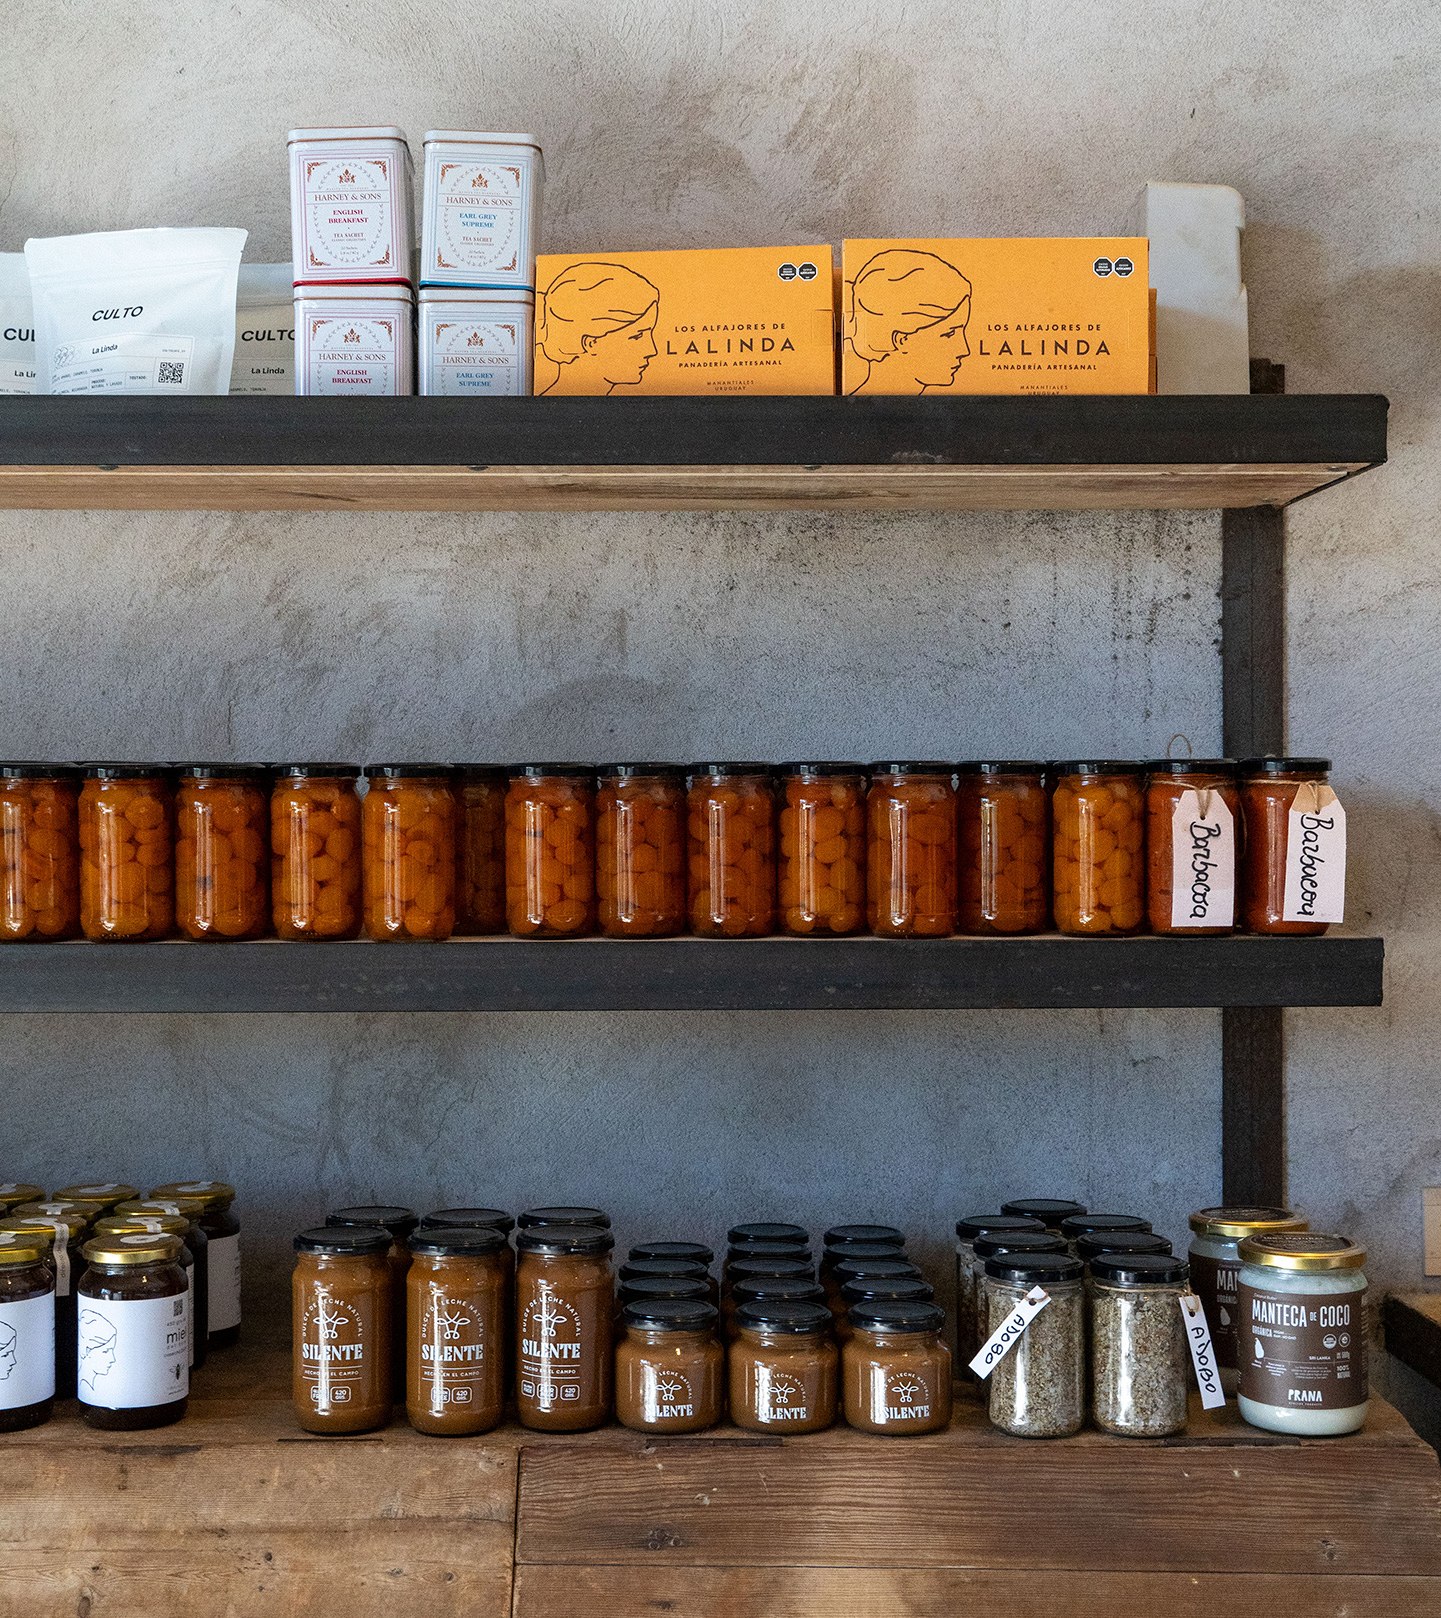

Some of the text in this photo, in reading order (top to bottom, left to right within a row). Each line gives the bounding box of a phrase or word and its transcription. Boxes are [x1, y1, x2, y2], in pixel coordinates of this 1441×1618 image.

[315, 193, 349, 201] HARNEY
[446, 196, 480, 204] HARNEY
[92, 305, 143, 322] CULTO
[4, 328, 35, 342] CUL
[675, 325, 696, 333] LOS
[702, 323, 766, 332] ALFAJORES
[100, 344, 118, 353] Linda
[442, 356, 477, 364] HARNEY
[678, 360, 728, 368] PANADERÍA
[1190, 821, 1221, 919] Barbacoa
[1297, 814, 1334, 916] Barbacoa
[321, 1298, 344, 1306] ECHE
[347, 1304, 363, 1337] NATURAL
[469, 1305, 484, 1337] NATURAL
[529, 1300, 538, 1308] DE
[539, 1296, 563, 1305] LCHE
[565, 1303, 581, 1337] NATURAL
[1252, 1299, 1350, 1328] MANTECA DE COCO
[166, 1325, 187, 1344] miel
[985, 1314, 1025, 1364] ADOBO
[302, 1342, 363, 1360] SILENTE
[422, 1343, 484, 1361] SILENTE
[522, 1338, 581, 1359] SILENTE
[1191, 1326, 1217, 1393] ADOBO
[1288, 1389, 1322, 1402] PRANA
[645, 1404, 693, 1417] SLENTE
[759, 1407, 806, 1420] LENTE
[883, 1405, 930, 1419] SILENTE
